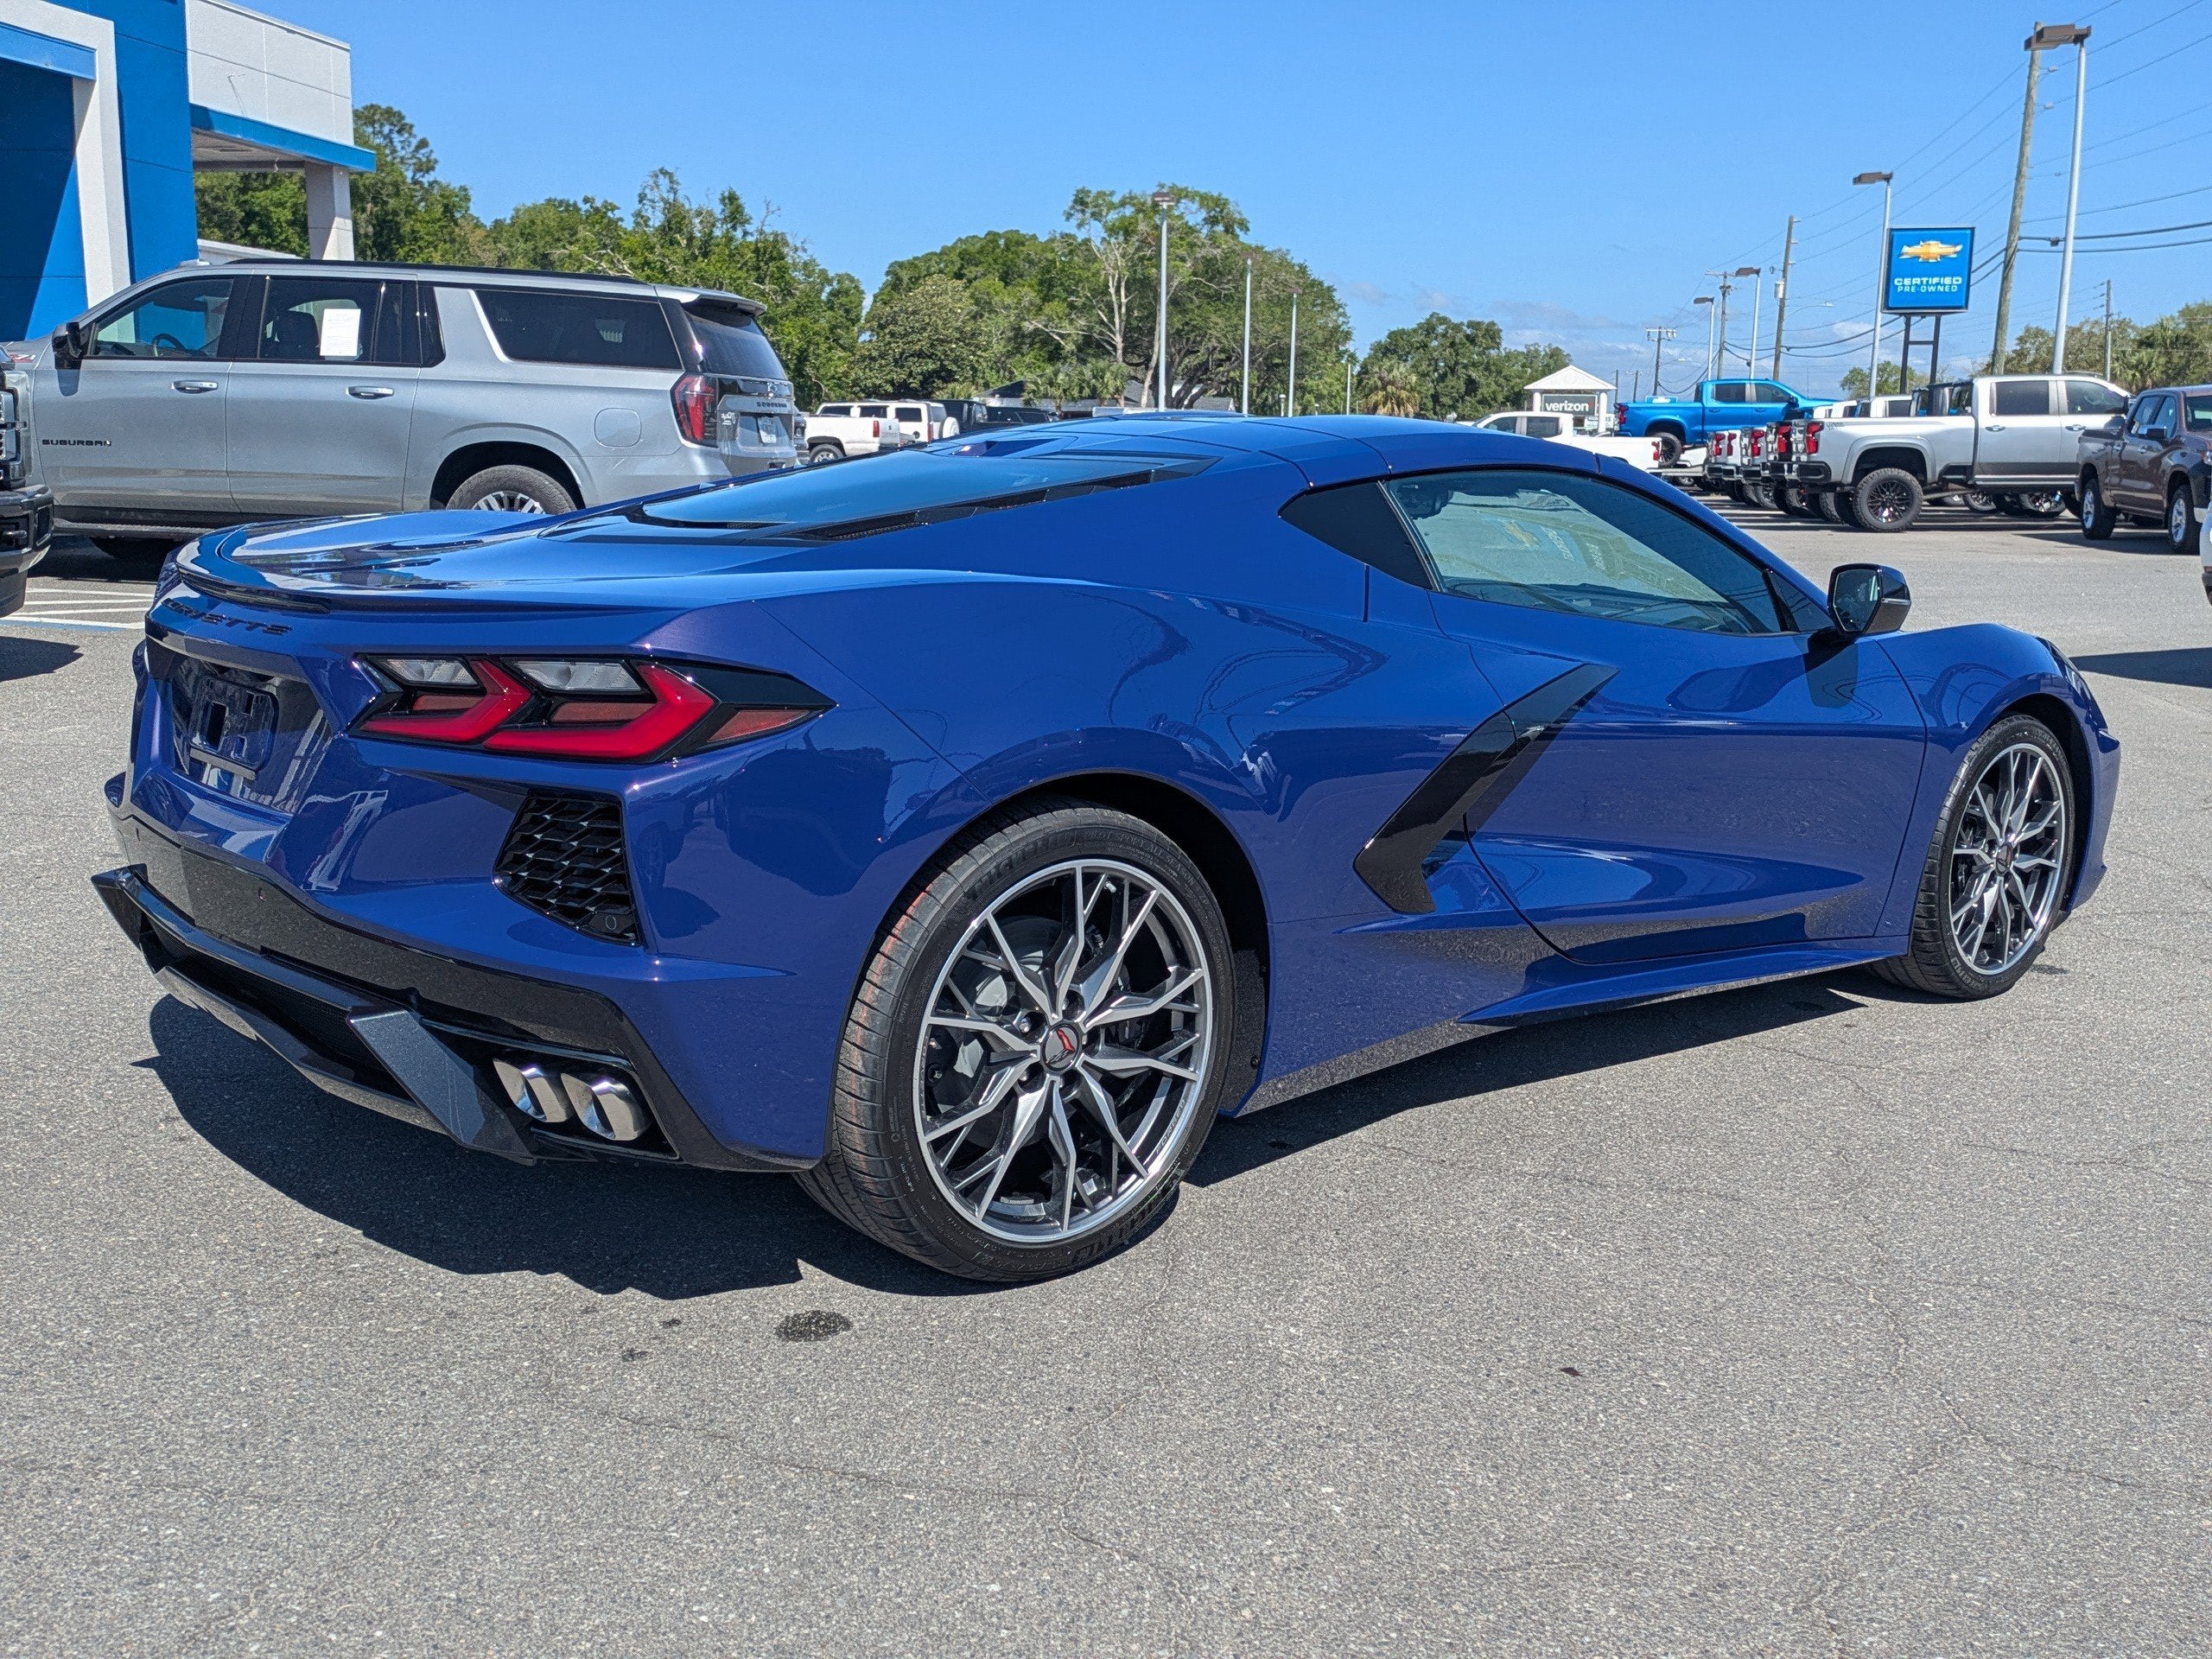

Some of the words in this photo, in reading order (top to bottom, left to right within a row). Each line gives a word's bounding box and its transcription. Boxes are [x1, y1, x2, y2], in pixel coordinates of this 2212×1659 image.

[1893, 276, 1962, 286] CERTIFIED
[1897, 284, 1959, 293] PRE-OWNED
[1545, 400, 1590, 412] verizon
